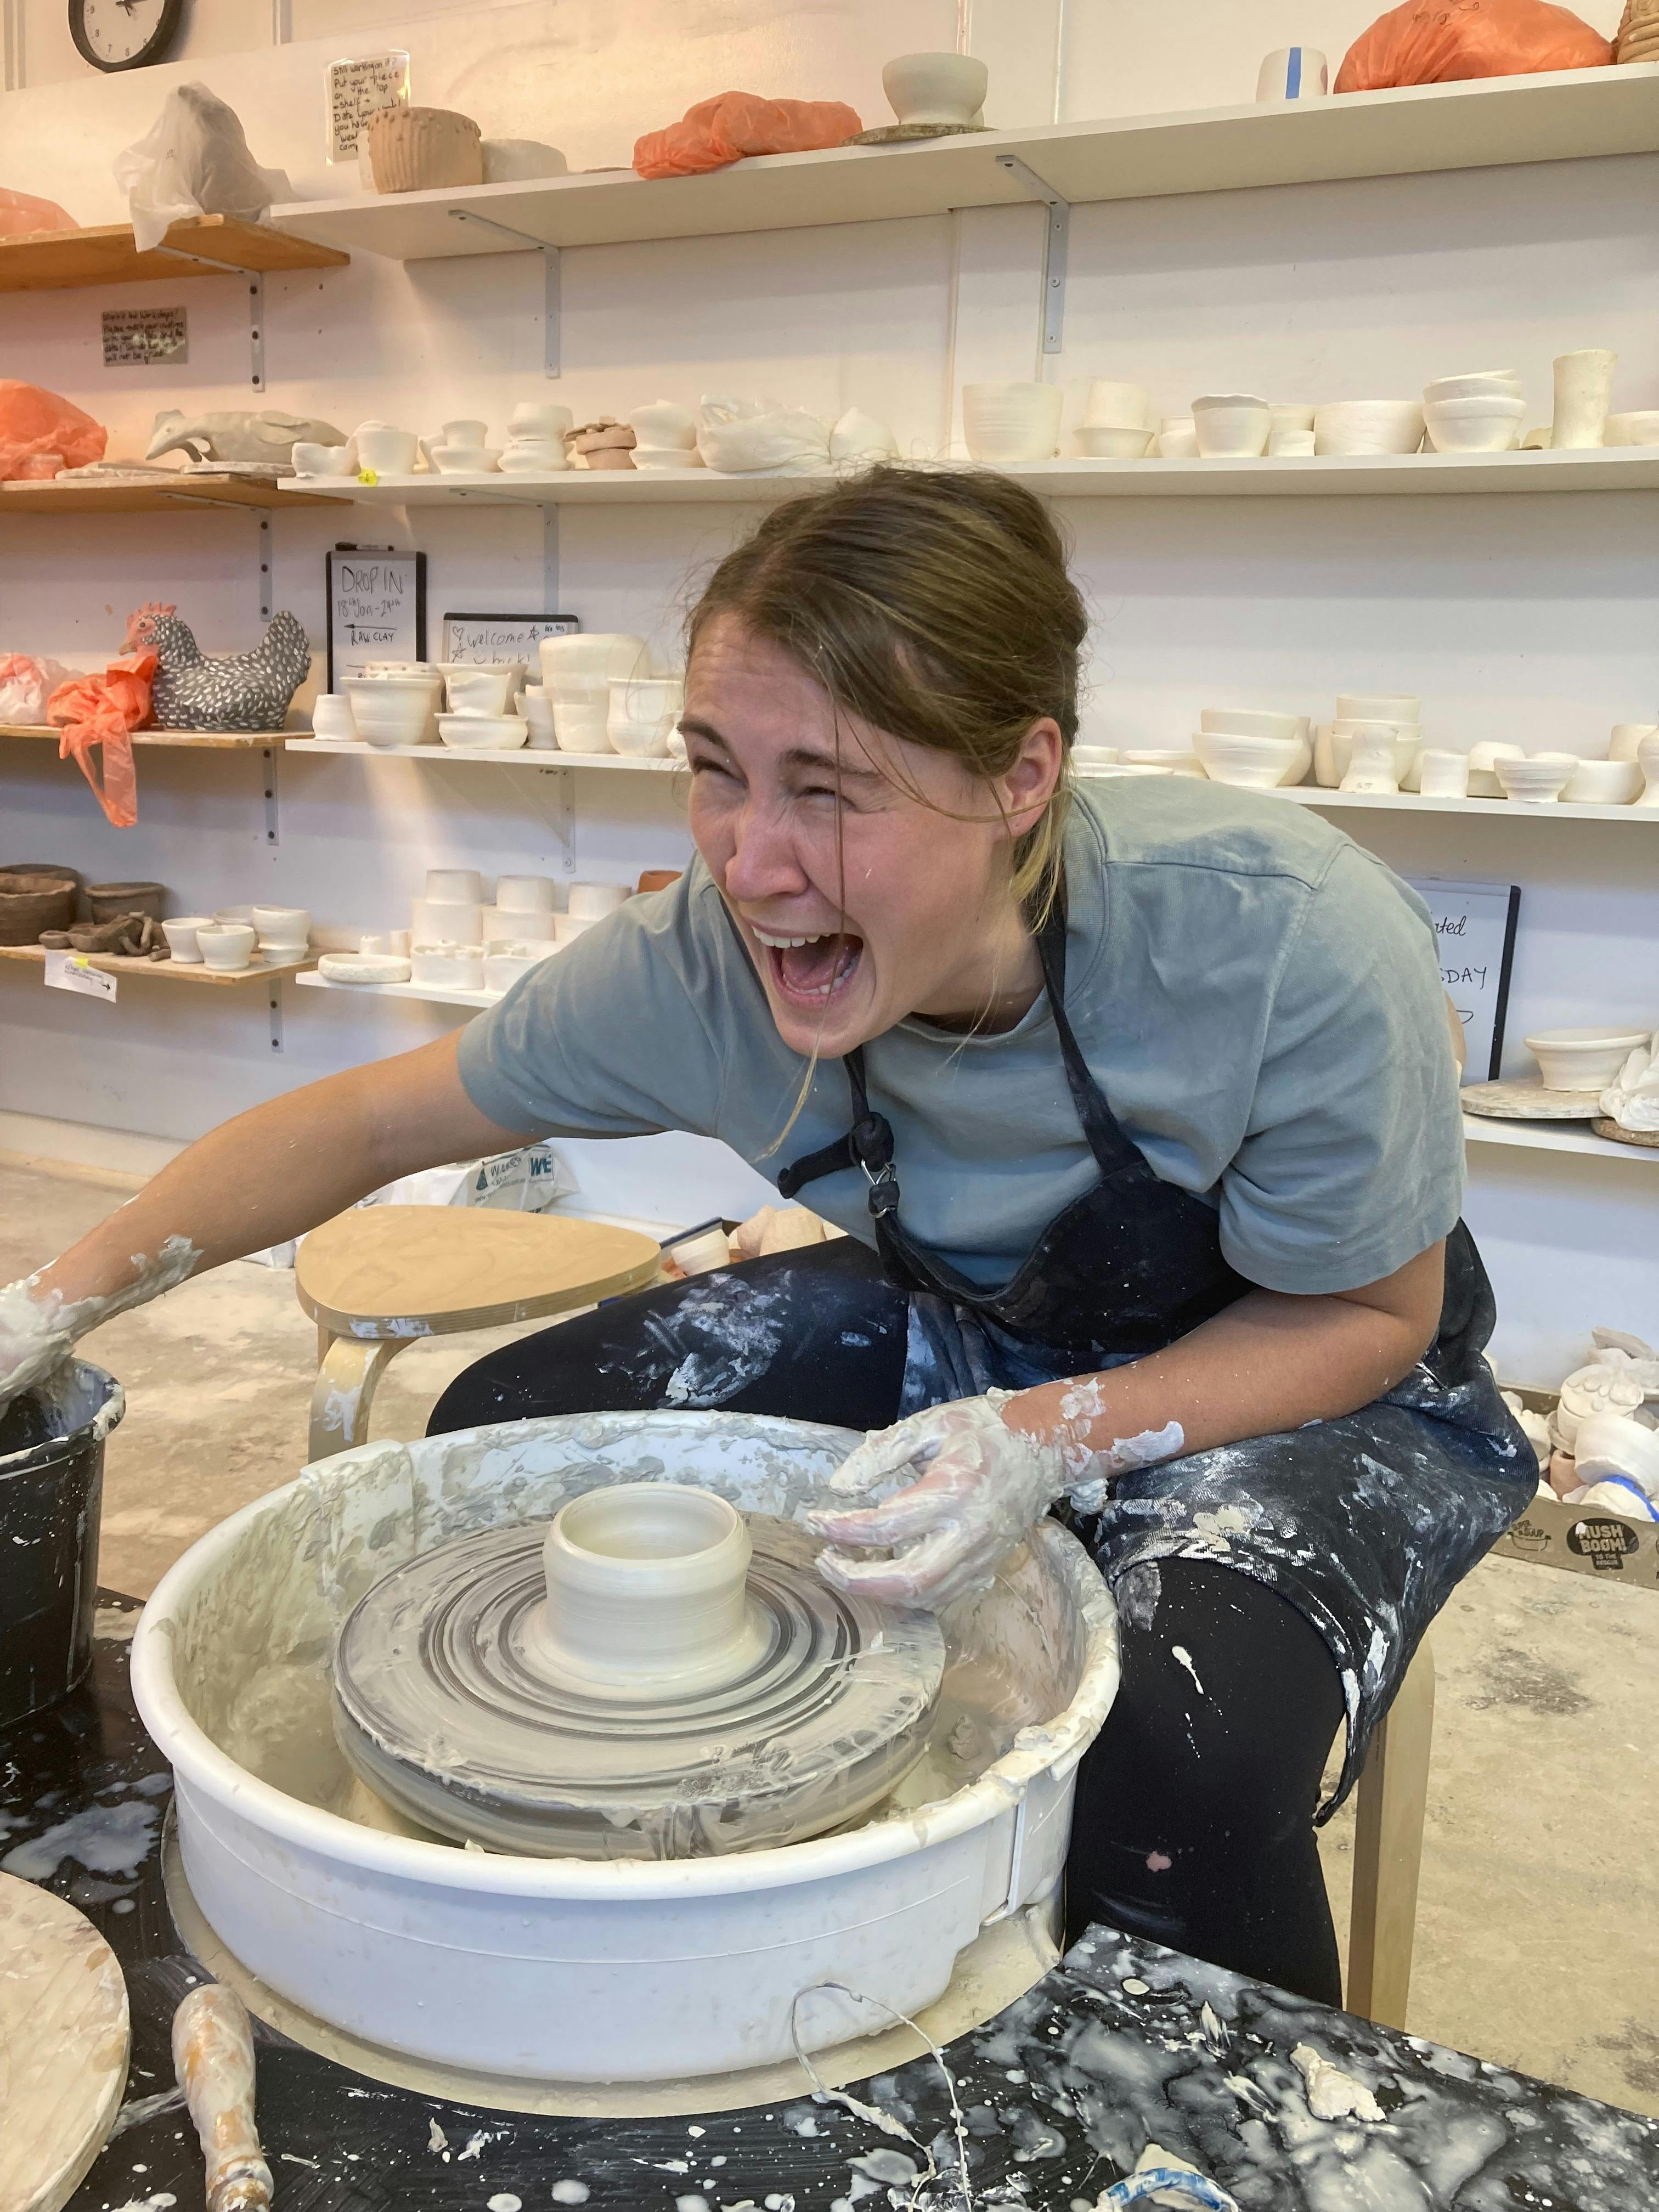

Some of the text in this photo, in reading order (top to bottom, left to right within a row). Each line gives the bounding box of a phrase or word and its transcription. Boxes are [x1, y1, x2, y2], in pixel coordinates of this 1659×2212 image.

[90, 5, 95, 14] 9
[95, 29, 100, 37] 8
[108, 44, 112, 53] 7
[334, 65, 347, 76] Still
[350, 61, 375, 78] working
[334, 76, 347, 88] Put
[349, 76, 366, 92] your
[357, 87, 369, 96] the
[340, 97, 360, 113] shelf
[334, 110, 353, 123] Date
[335, 124, 349, 136] you
[342, 566, 403, 595] DROP IN
[351, 630, 394, 646] RAW CLAY
[1434, 915, 1467, 936] rted
[1578, 1524, 1624, 1540] MUSH
[1579, 1537, 1627, 1554] BOOM!
